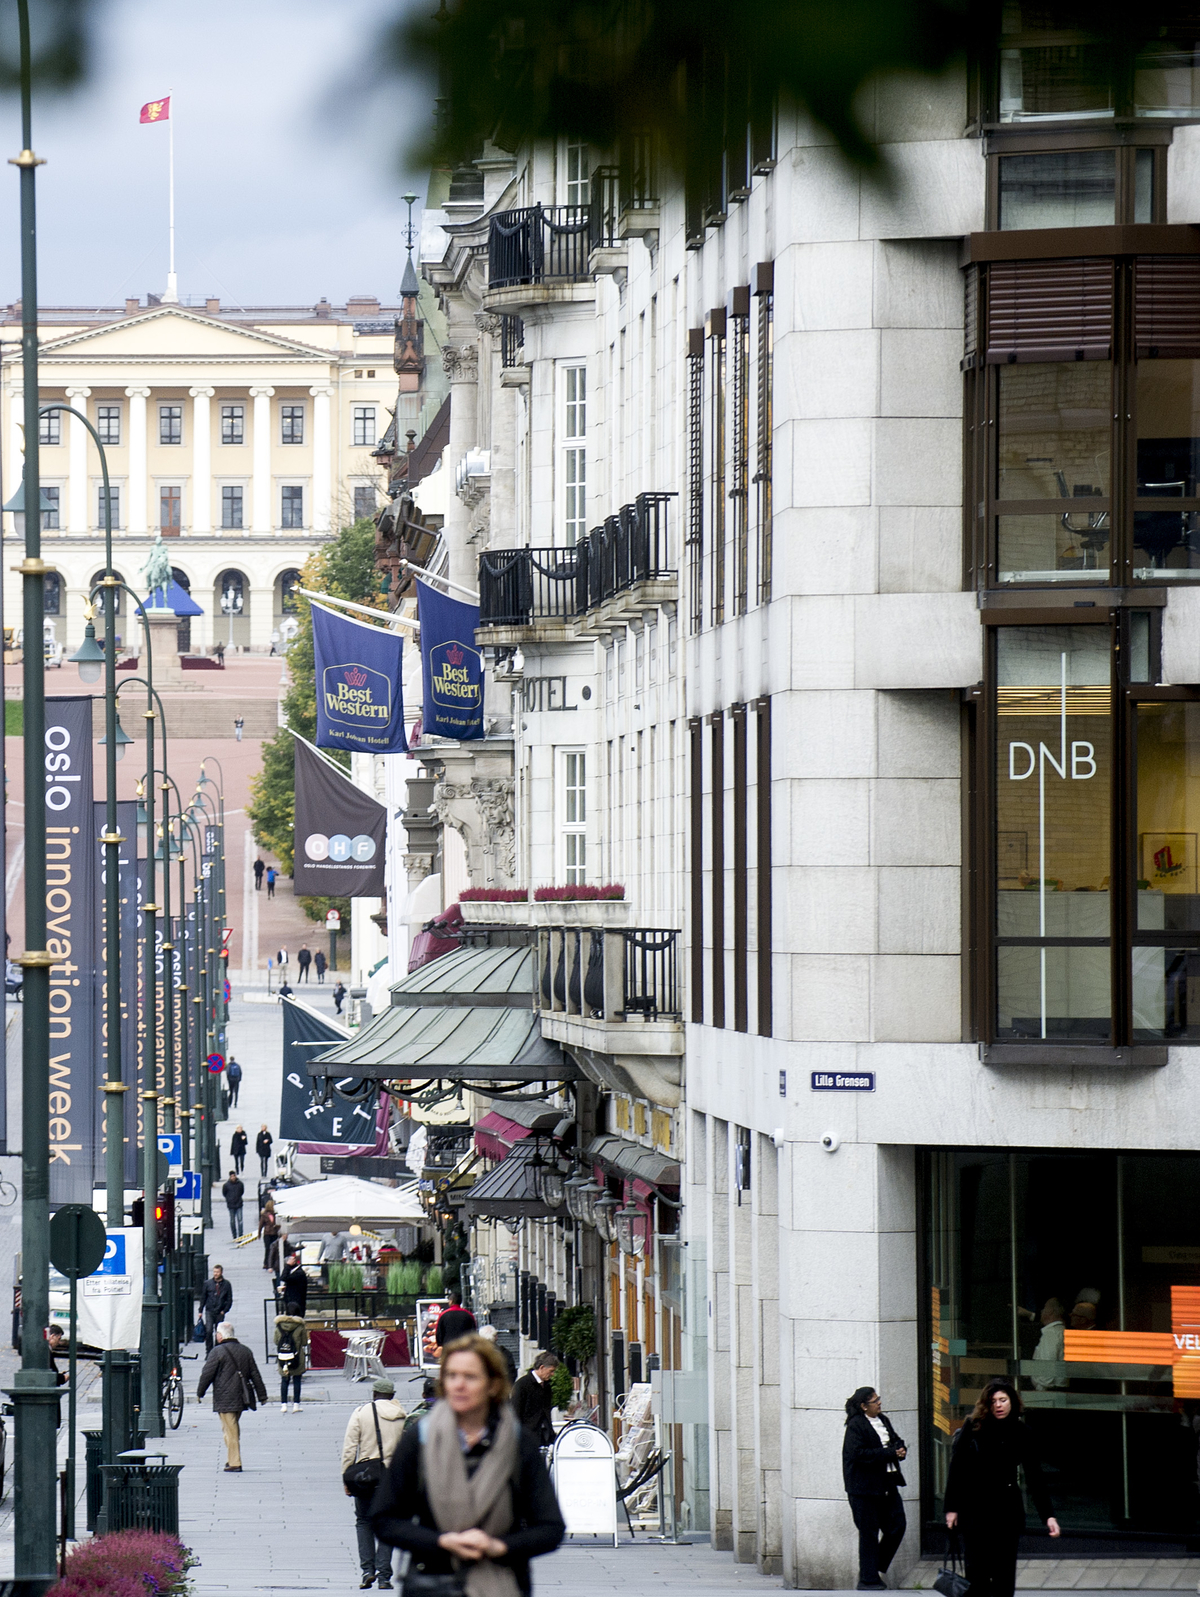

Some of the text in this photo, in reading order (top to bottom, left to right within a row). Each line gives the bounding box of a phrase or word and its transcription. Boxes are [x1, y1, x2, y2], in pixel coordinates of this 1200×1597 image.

[441, 663, 469, 683] Best
[337, 682, 373, 703] Best
[523, 676, 578, 712] HOTEL
[326, 692, 389, 718] Western
[45, 826, 81, 1039] innovation
[815, 1074, 870, 1088] Lille Grensen
[49, 1052, 83, 1167] week
[565, 1498, 607, 1508] DROP-IN
